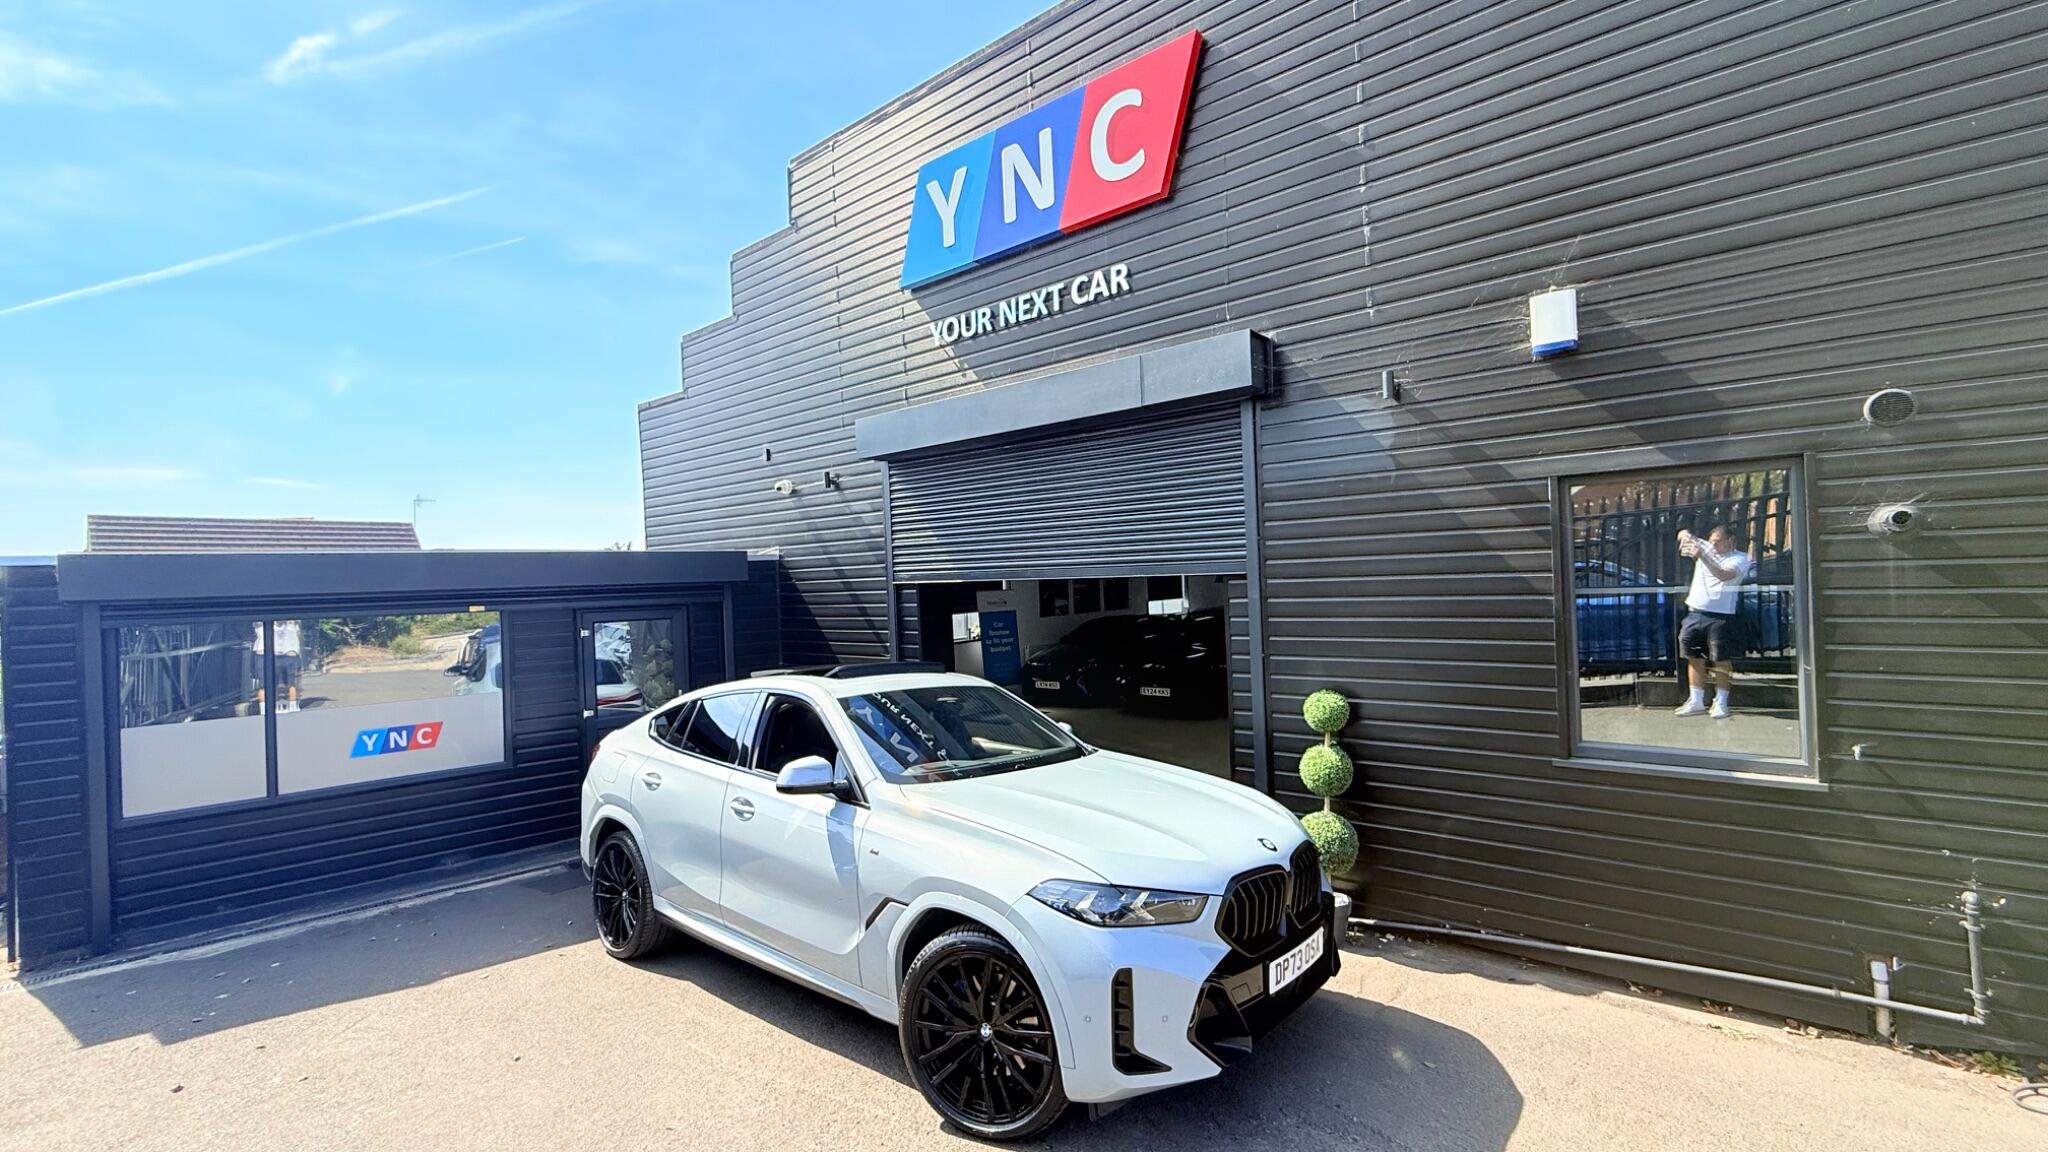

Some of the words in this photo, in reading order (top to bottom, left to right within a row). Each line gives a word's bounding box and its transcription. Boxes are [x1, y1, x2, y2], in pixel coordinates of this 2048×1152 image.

[926, 88, 1145, 247] YNC
[930, 307, 992, 347] YOUR
[999, 283, 1065, 325] NEXT
[1071, 263, 1131, 306] CAR
[361, 727, 433, 752] YNC
[1275, 949, 1303, 986] DP73
